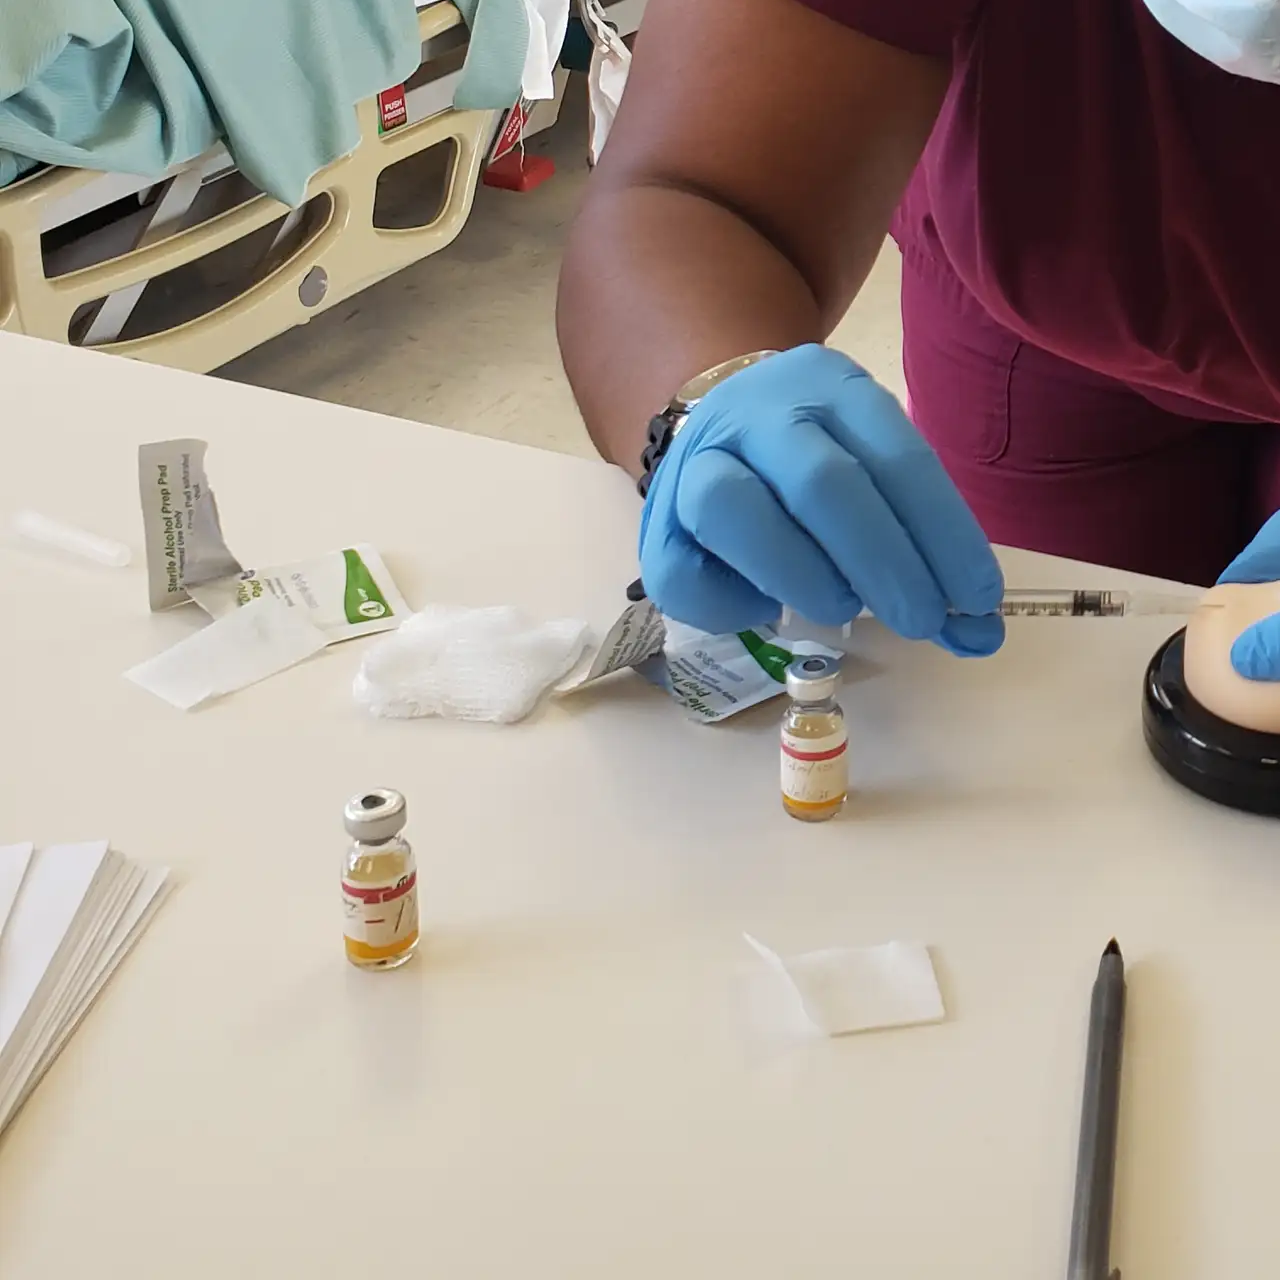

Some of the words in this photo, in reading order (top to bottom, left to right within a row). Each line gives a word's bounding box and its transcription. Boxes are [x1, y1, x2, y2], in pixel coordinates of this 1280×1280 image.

[384, 98, 403, 113] PUSH
[156, 464, 168, 486] Pad
[160, 488, 172, 514] Prep
[162, 516, 177, 559] Alcohol
[166, 561, 178, 593] Sterile
